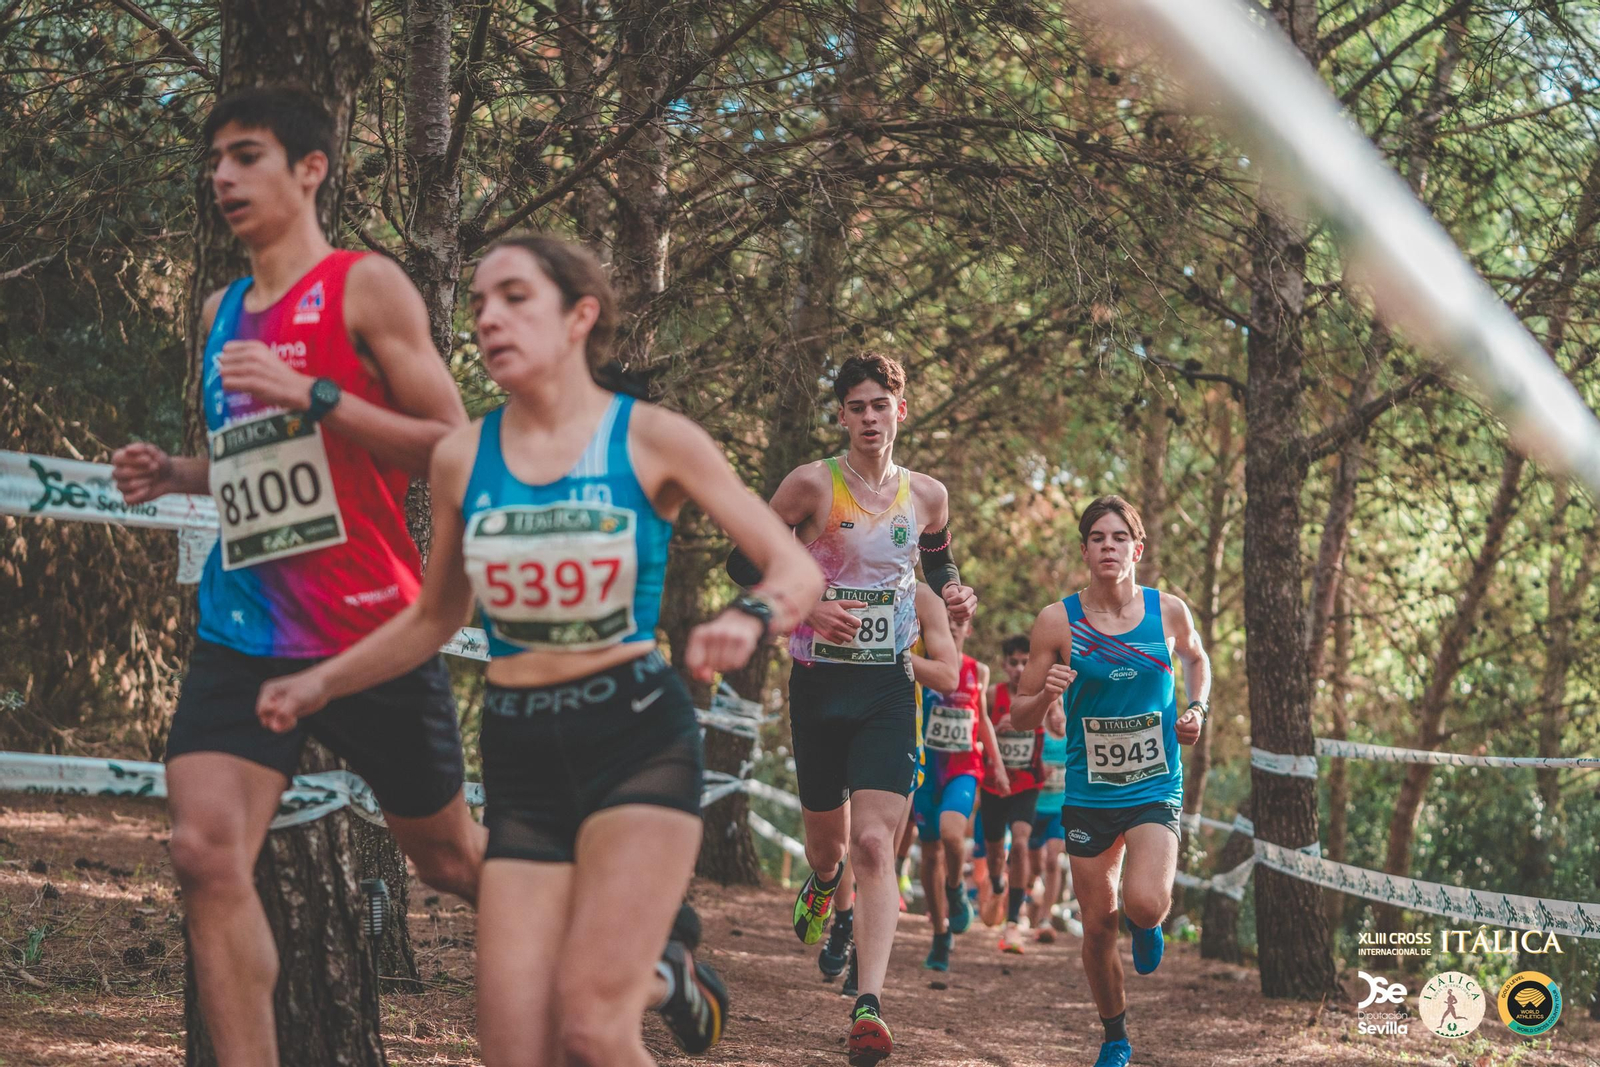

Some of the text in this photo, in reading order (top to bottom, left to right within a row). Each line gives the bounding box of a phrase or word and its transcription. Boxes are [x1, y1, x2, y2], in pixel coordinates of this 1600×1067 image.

[220, 461, 321, 526] 8100
[485, 557, 621, 609] 5397
[858, 617, 888, 642] 89
[524, 676, 617, 718] PRO
[931, 722, 967, 740] 8101
[1094, 738, 1159, 767] 5943
